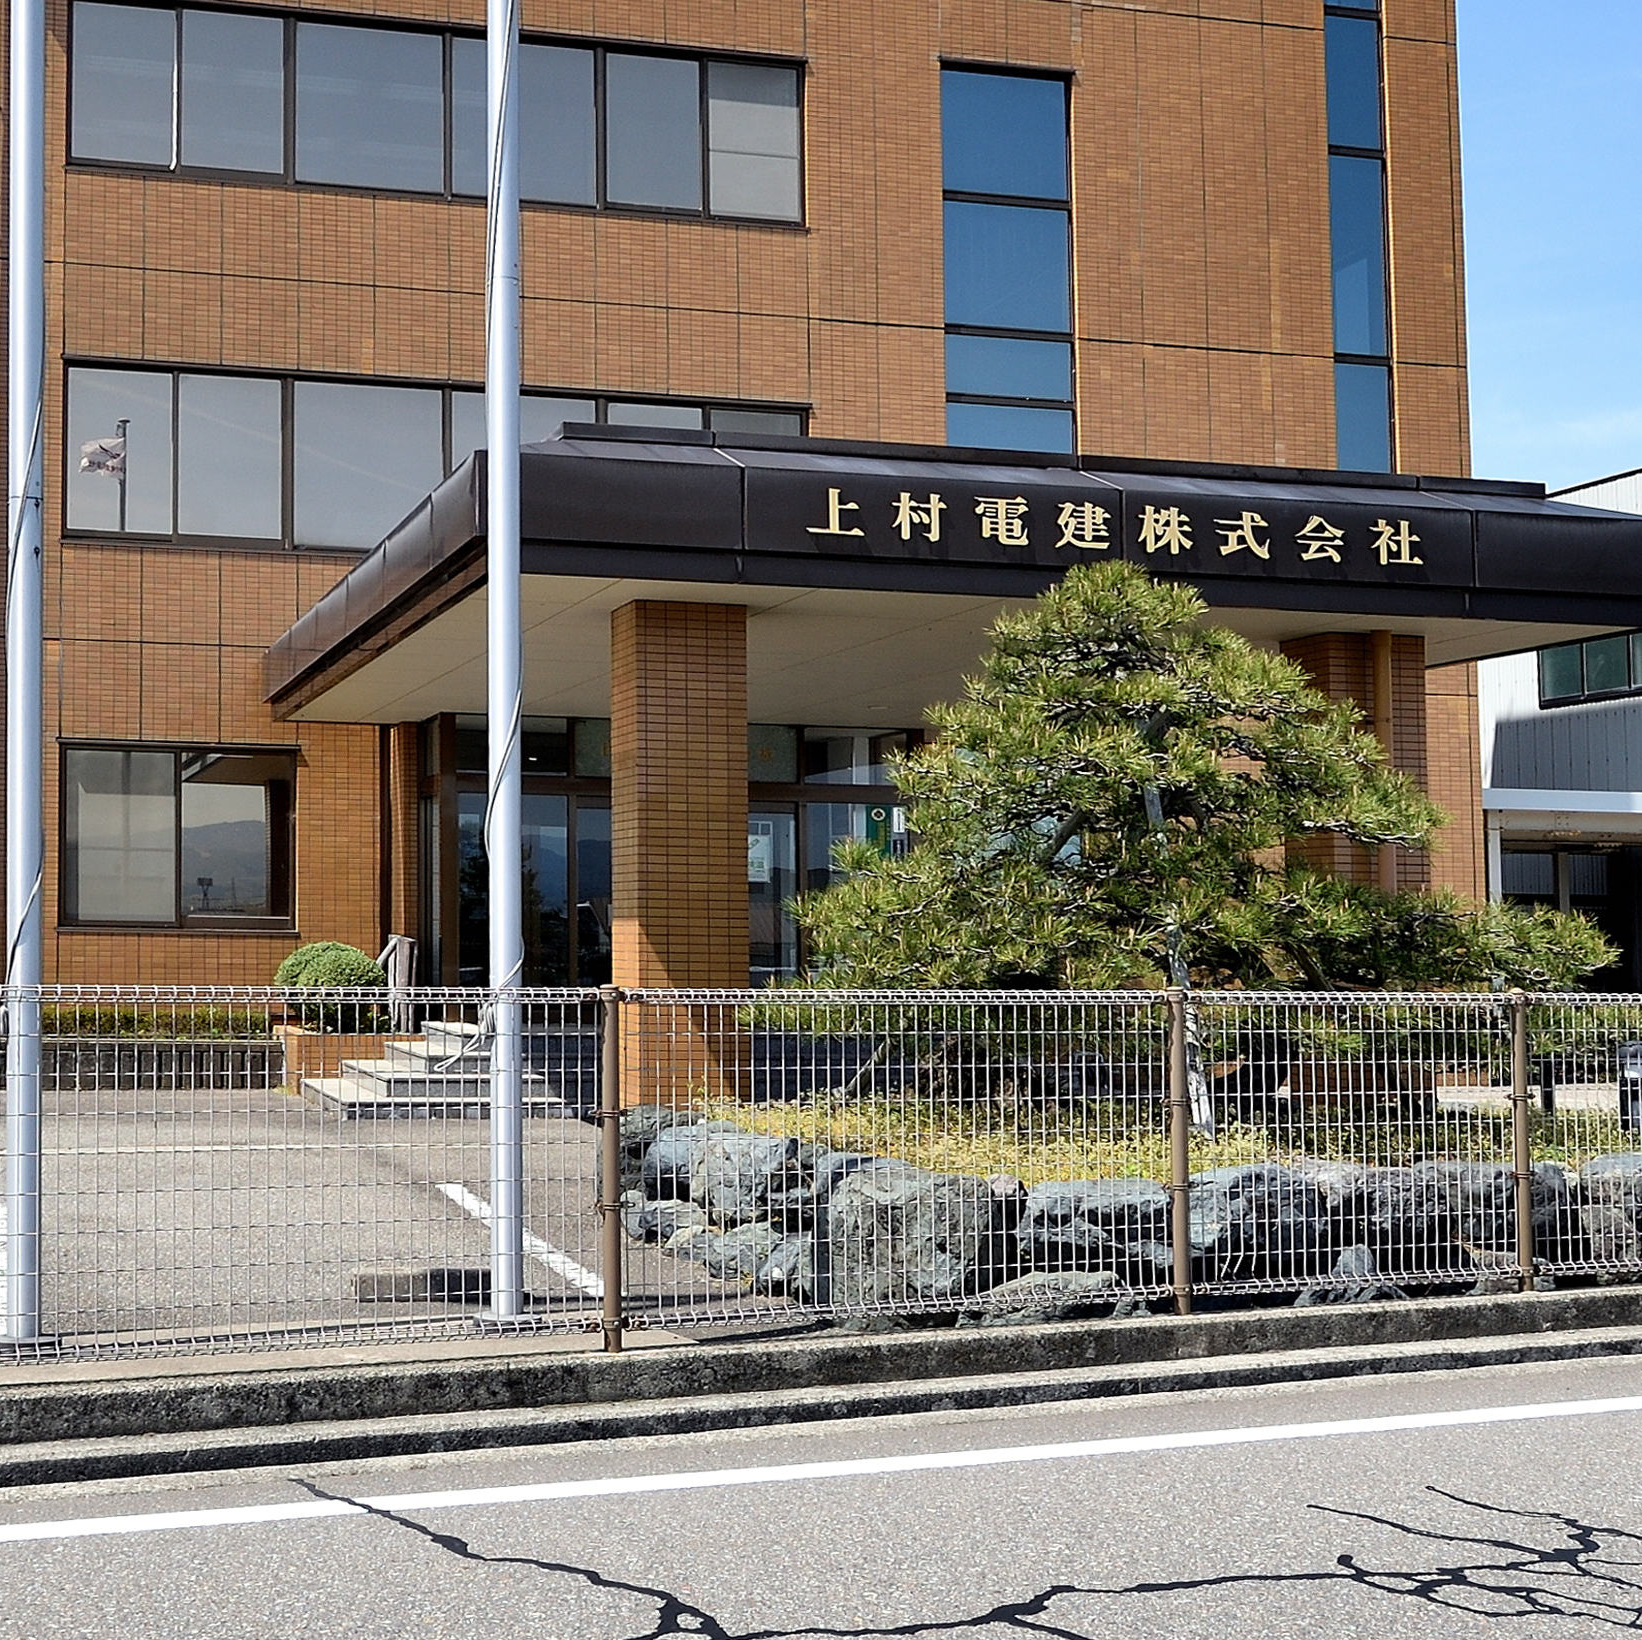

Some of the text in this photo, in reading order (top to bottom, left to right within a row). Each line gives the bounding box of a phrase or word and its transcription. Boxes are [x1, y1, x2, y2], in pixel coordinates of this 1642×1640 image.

[806, 487, 1424, 565] 上村電建株式会社
